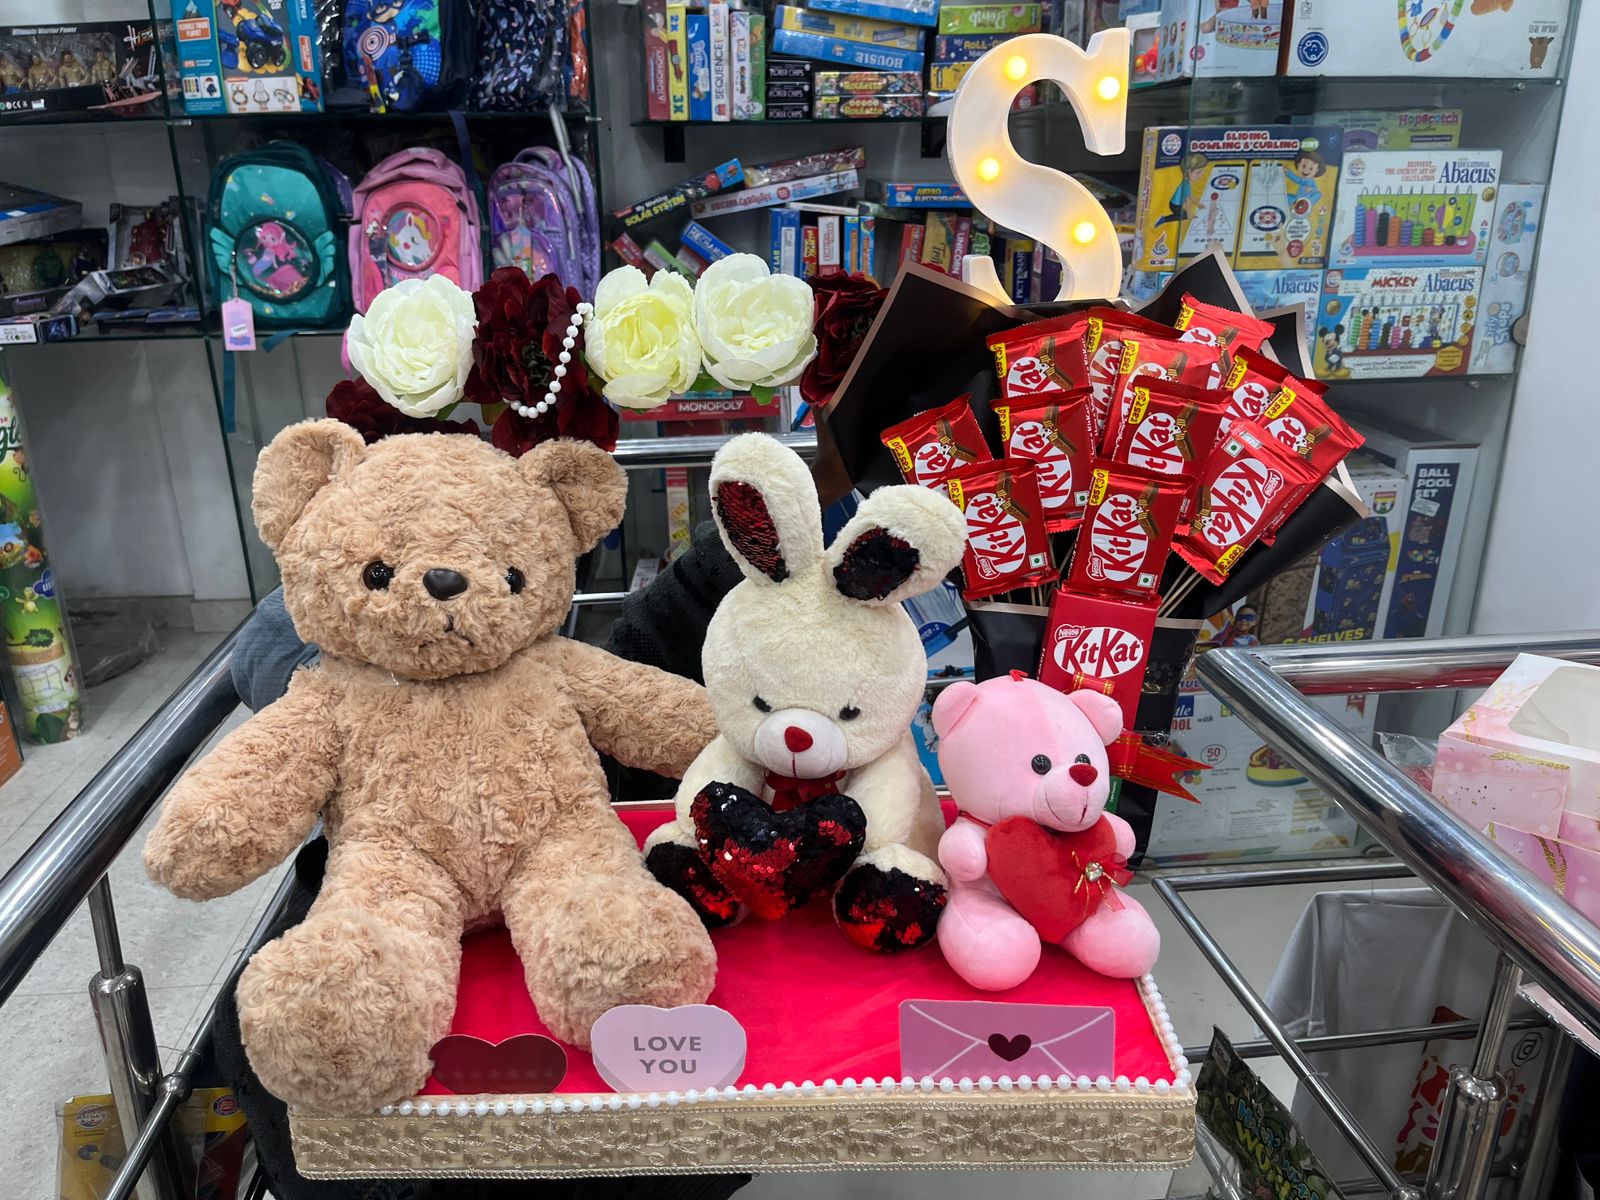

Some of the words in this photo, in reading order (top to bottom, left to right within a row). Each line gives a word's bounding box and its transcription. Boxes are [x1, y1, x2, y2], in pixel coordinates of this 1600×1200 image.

[855, 51, 904, 68] HOUSIE
[715, 42, 725, 100] SEQUENCE
[1399, 112, 1459, 127] Hopscotch
[1225, 131, 1268, 140] SLIDING
[1191, 141, 1241, 150] BOWLING
[1252, 140, 1299, 149] CURLING
[1438, 161, 1497, 184] Abacus
[625, 207, 652, 226] SOLAR
[653, 194, 687, 215] SYSTEM
[952, 231, 966, 275] UNICORN
[1271, 273, 1319, 295] Abacus
[1371, 276, 1418, 288] MICKEY
[1423, 273, 1475, 292] Abacus
[1495, 301, 1513, 345] Steps
[678, 400, 744, 413] MONOPOLY
[1418, 467, 1451, 479] BALL
[1416, 477, 1453, 489] POOL
[1415, 488, 1439, 499] SET
[1208, 461, 1266, 546] KitKat
[967, 495, 1026, 570] KitKat
[1093, 495, 1149, 579] KitKat
[1060, 628, 1141, 677] KitKat
[1197, 715, 1214, 723] with
[1207, 747, 1221, 758] 50
[633, 1036, 702, 1052] LOVE
[639, 1058, 698, 1075] YOU
